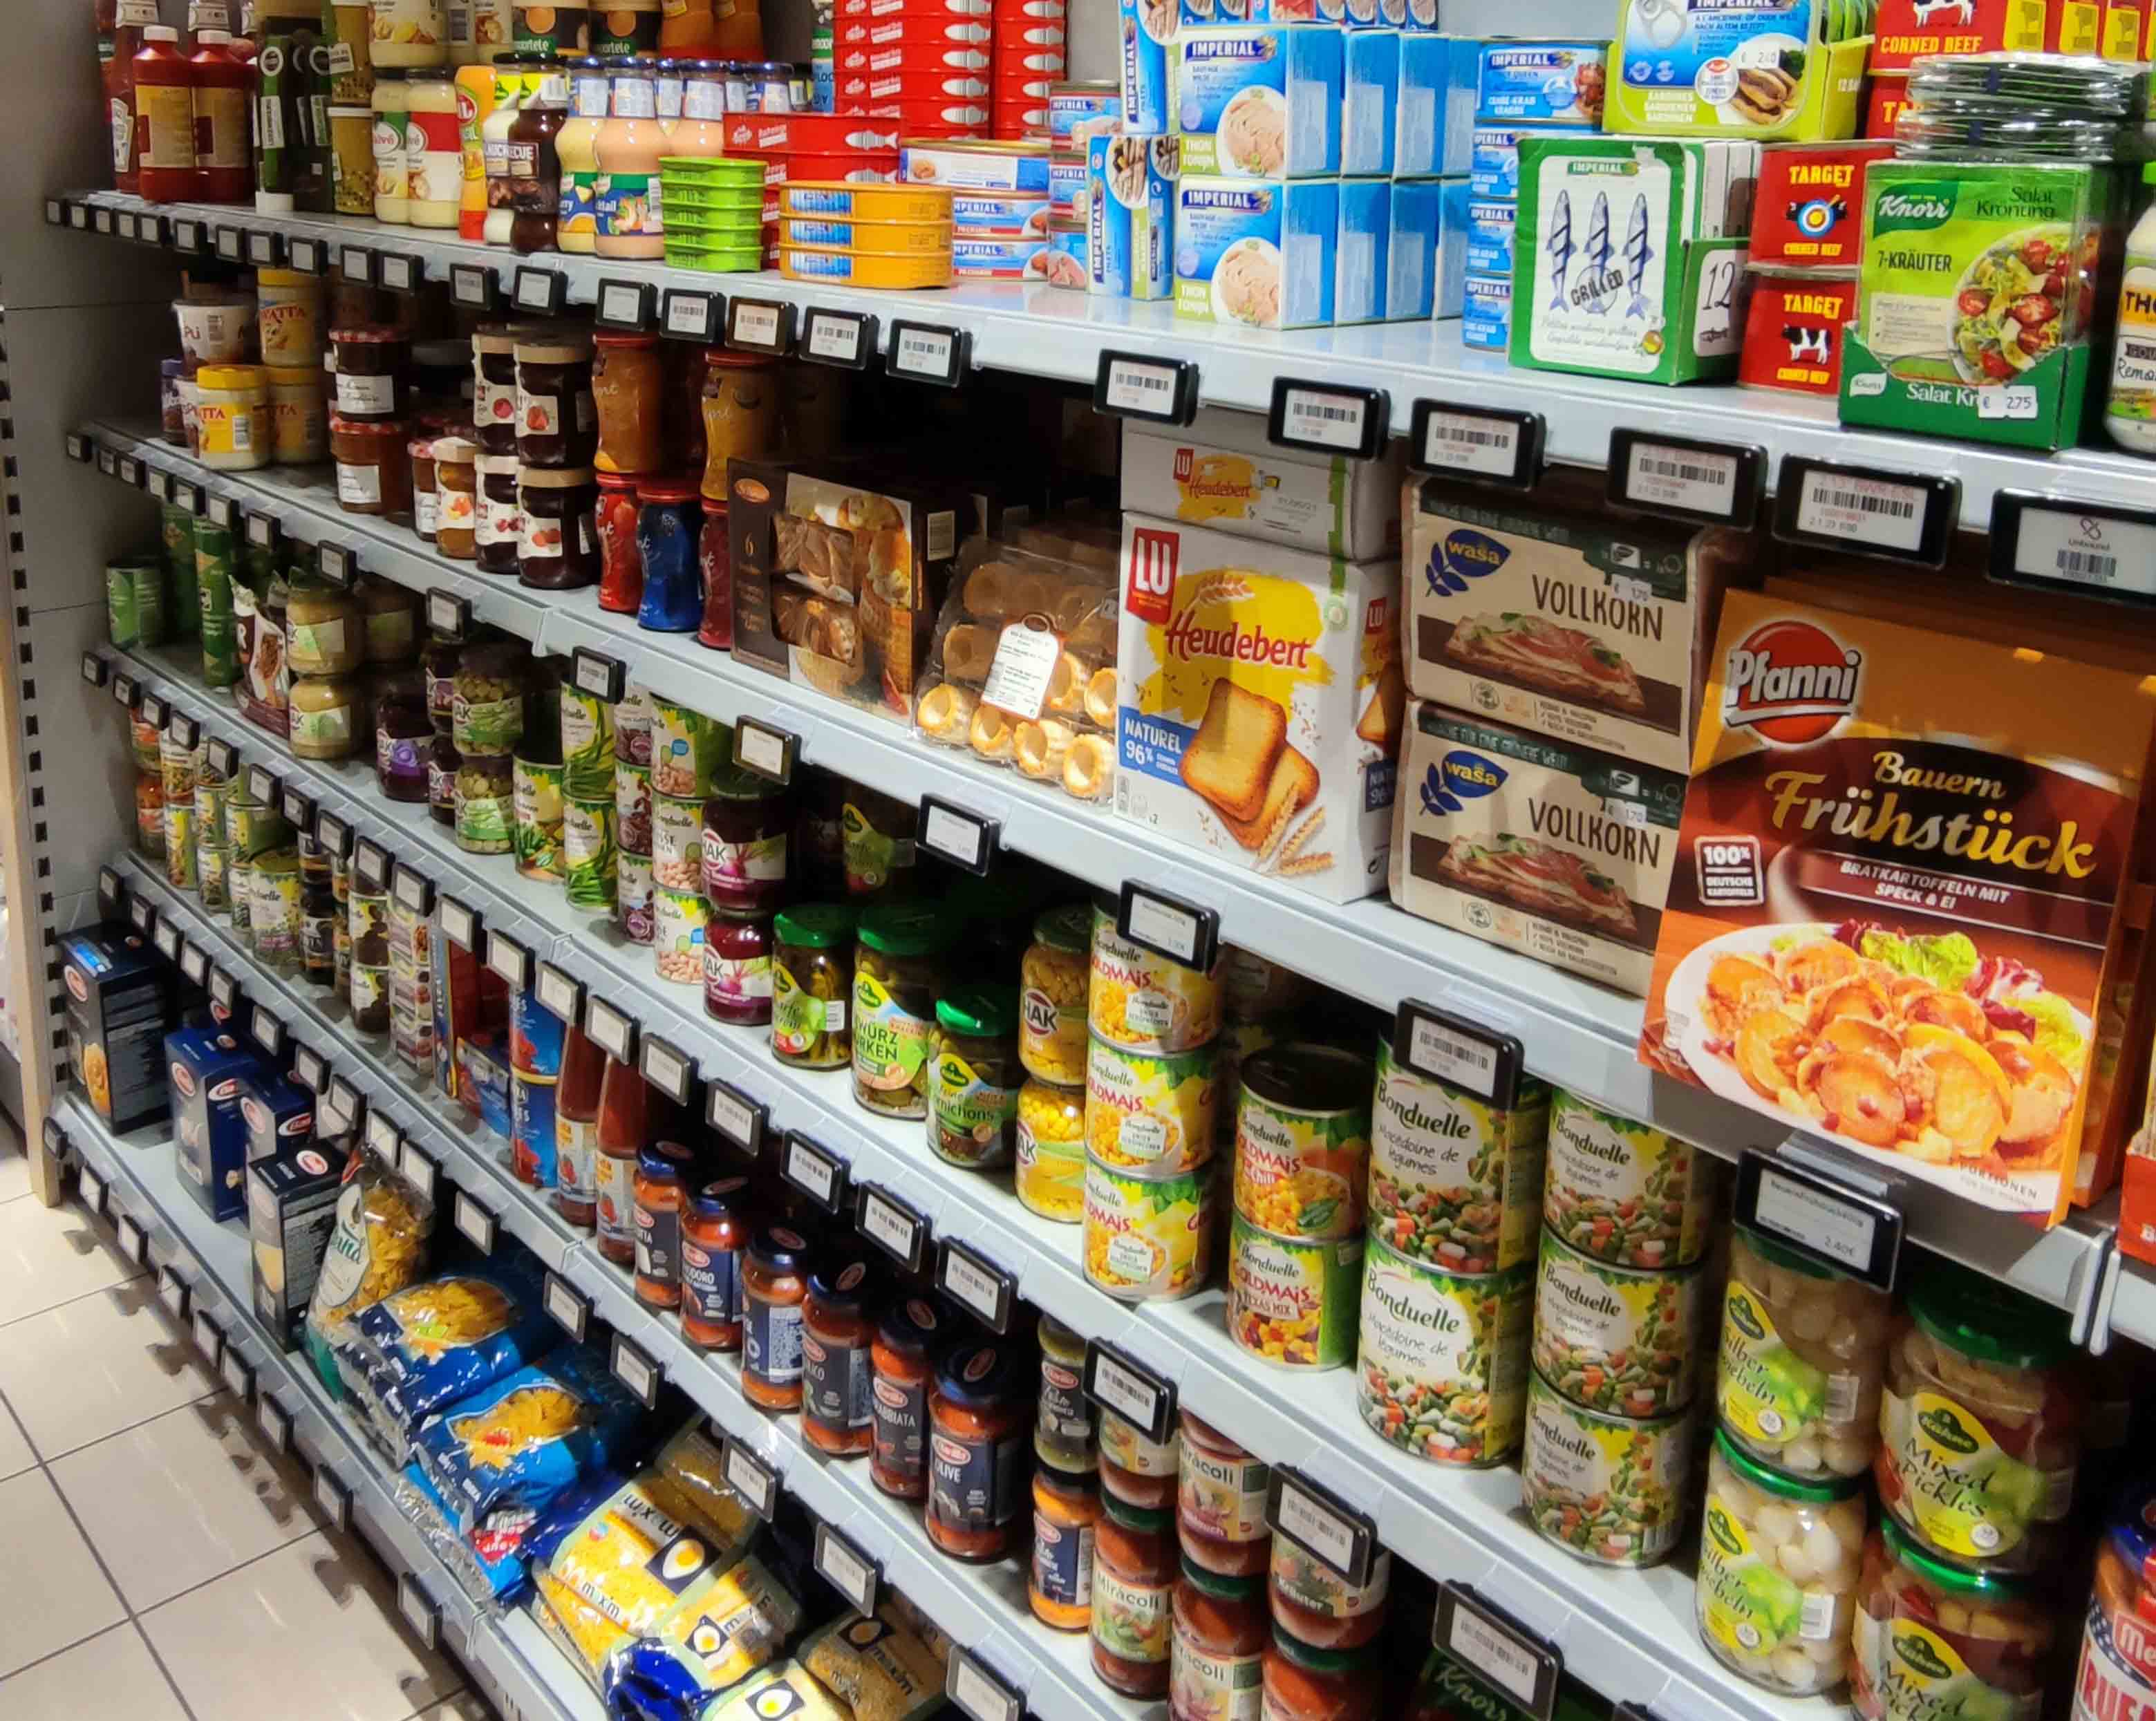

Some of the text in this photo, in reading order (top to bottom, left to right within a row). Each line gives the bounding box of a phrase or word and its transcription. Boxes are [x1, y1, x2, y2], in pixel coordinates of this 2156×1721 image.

[1192, 41, 1256, 57] IMPERIAL
[1491, 54, 1550, 66] IMPERIAL
[1880, 36, 1982, 54] CORNED BEEF
[1126, 40, 1137, 115] IMPERIAL
[1789, 165, 1855, 188] TARGET
[1188, 191, 1252, 207] IMPERIAL
[1877, 192, 1951, 220] Knorr
[2010, 187, 2053, 203] Salat
[1093, 202, 1104, 275] IMPERIAL
[1877, 249, 1953, 273] 7-KRÄUTER
[1570, 269, 1624, 306] GRILLED
[1702, 261, 1736, 310] 12
[1783, 294, 1844, 320] TARGET
[1906, 383, 1952, 404] Salat
[1176, 449, 1191, 477] LU
[1189, 480, 1250, 499] Heudebert
[1134, 536, 1171, 596] LU
[1532, 574, 1664, 641] VOLLKORN
[1164, 608, 1312, 669] Heudebert
[1727, 647, 1863, 707] Pfanni
[1124, 717, 1183, 755] NATUREL
[1125, 739, 1154, 766] 96%
[1445, 760, 1499, 789] wasa
[1872, 751, 2007, 801] Bauern
[1528, 796, 1661, 869] VOLLKORN
[1765, 768, 2099, 880] Frühstück
[1703, 845, 1752, 865] 100%
[1839, 859, 2010, 905] BRATKARTOFFELN MIT
[1875, 882, 1922, 905] SPECK
[1940, 892, 1956, 910] EI
[1378, 1080, 1472, 1140] Bonduelle
[1440, 1148, 1461, 1164] de
[1555, 1113, 1631, 1167] Bonduelle
[1241, 1245, 1300, 1279] Bonduelle
[1367, 1268, 1461, 1335] Bonduelle
[1545, 1265, 1621, 1318] Bonduelle
[1272, 1302, 1292, 1317] MIX
[1429, 1342, 1450, 1358] de
[1904, 1436, 1996, 1494] Mixed
[1901, 1458, 1988, 1518] Pickles
[1882, 1659, 1971, 1718] Mixed
